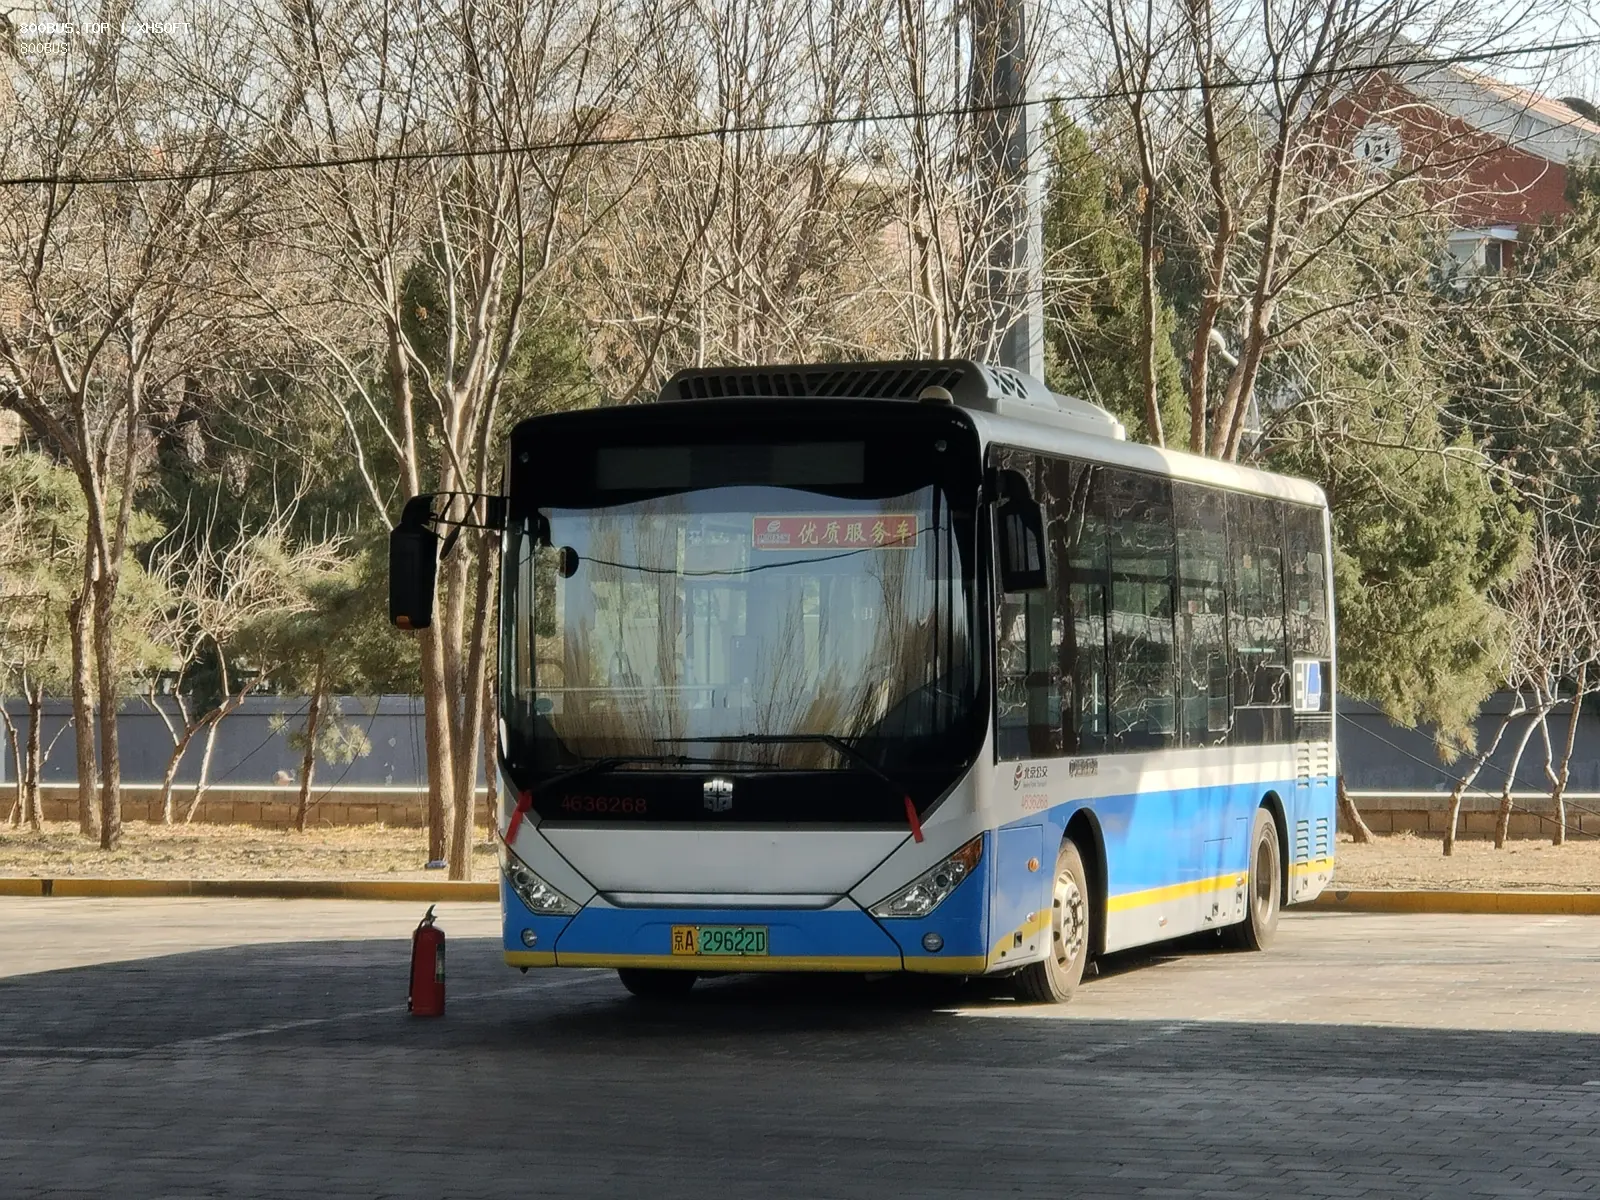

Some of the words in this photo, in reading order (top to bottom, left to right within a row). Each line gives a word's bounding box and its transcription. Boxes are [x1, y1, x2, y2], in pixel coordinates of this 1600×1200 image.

[798, 519, 912, 545] 优质服务车
[561, 795, 647, 813] 4636268
